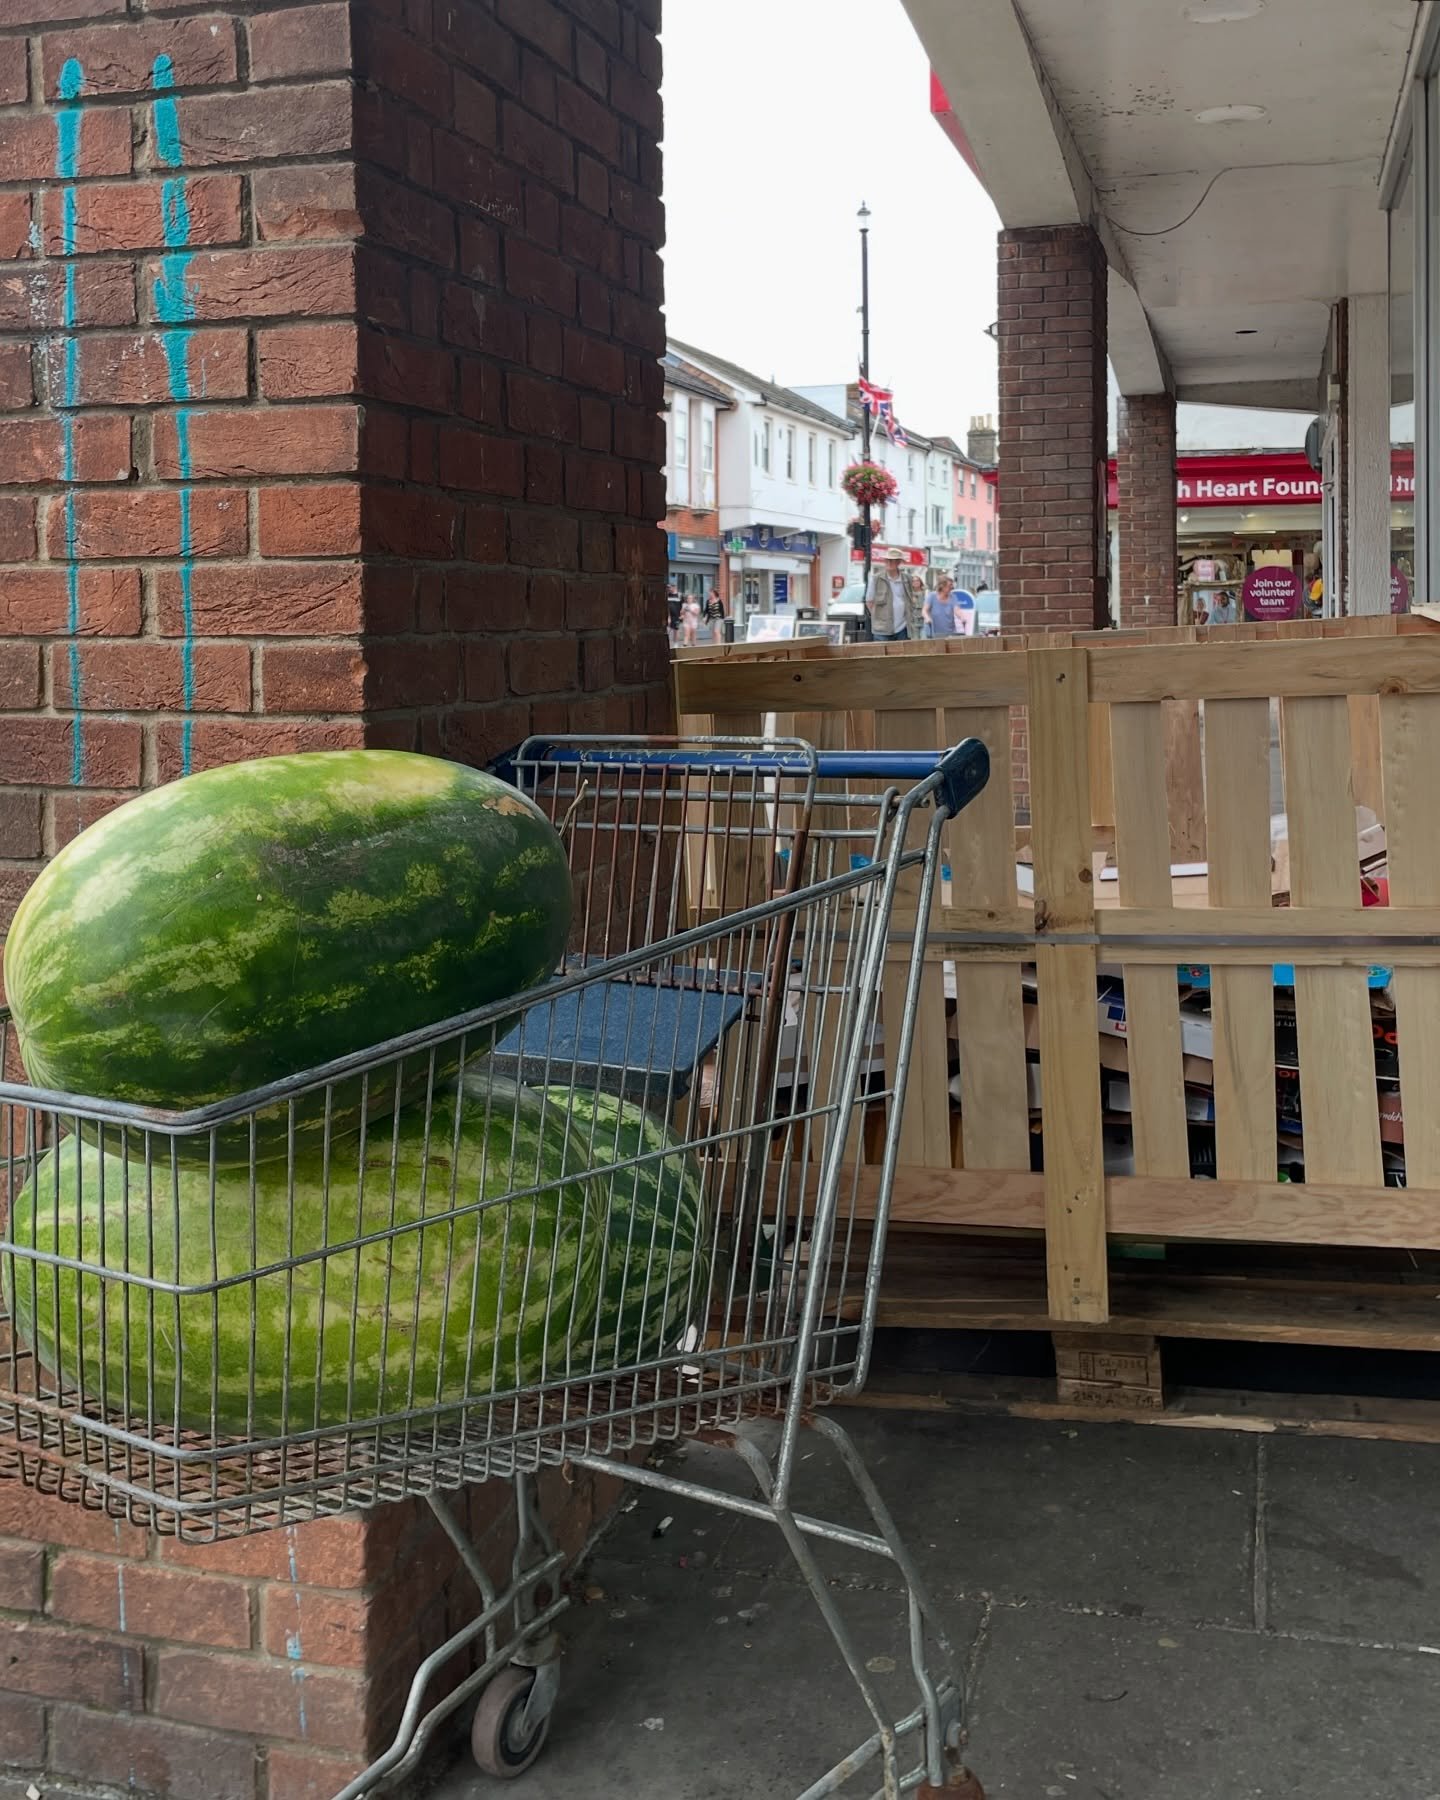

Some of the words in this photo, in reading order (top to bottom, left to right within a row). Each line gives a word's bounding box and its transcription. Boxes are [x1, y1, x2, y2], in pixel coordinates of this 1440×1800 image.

[1197, 480, 1258, 498] Heart
[1253, 579, 1273, 588] Join
[1249, 588, 1295, 597] volunteer
[1260, 597, 1285, 606] team
